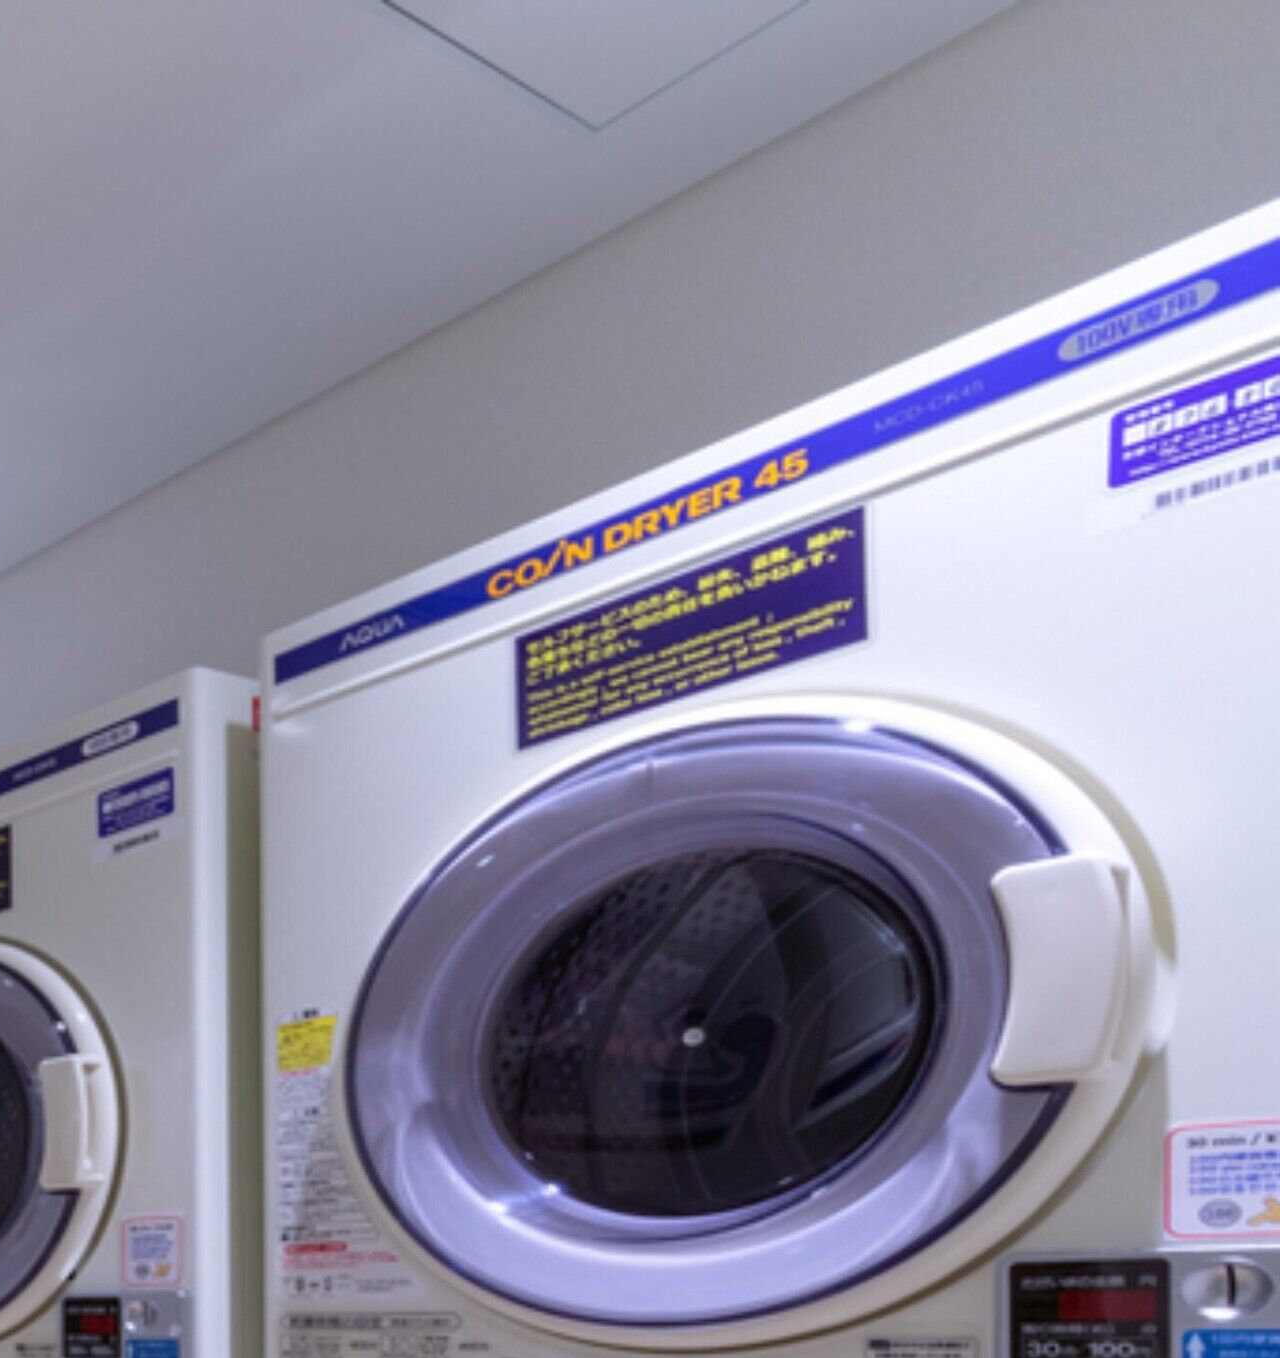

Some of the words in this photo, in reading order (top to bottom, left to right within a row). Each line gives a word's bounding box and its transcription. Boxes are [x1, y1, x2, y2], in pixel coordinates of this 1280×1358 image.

[340, 615, 403, 652] AQUA
[602, 477, 742, 554] DRYER
[754, 449, 808, 489] 45
